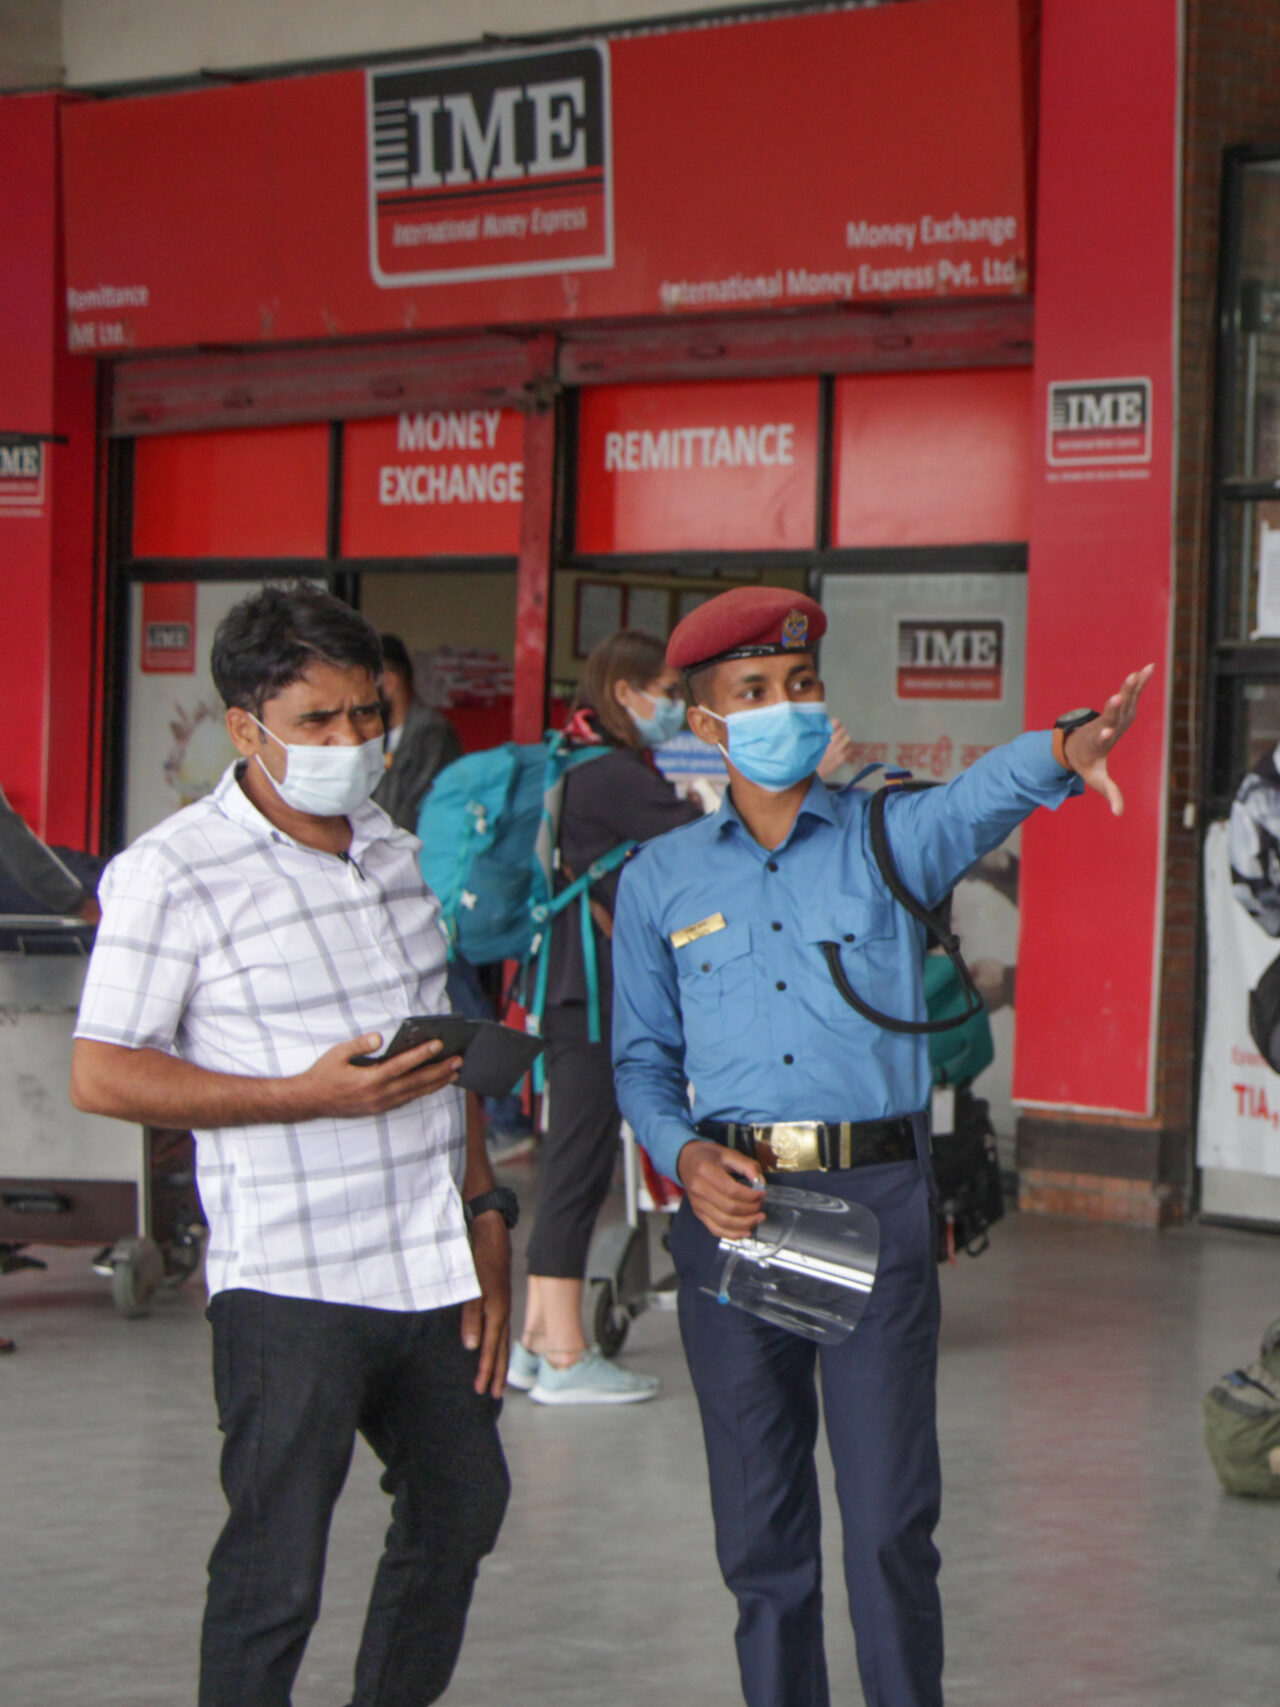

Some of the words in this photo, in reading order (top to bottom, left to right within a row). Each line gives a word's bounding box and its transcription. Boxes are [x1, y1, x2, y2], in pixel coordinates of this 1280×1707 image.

[409, 77, 587, 187] IME
[393, 215, 480, 247] International
[483, 213, 527, 239] Money
[531, 206, 588, 236] Express
[846, 221, 916, 250] Money
[920, 212, 1016, 247] Exchange
[787, 270, 855, 299] Money
[859, 264, 934, 295] Express
[397, 410, 501, 451] MONEY
[1068, 392, 1142, 430] IME
[0, 446, 38, 476] ME
[605, 423, 795, 471] REMITTANCE
[379, 462, 524, 505] EXCHANGE
[914, 629, 996, 668] IME
[1231, 1083, 1280, 1130] TIA,
